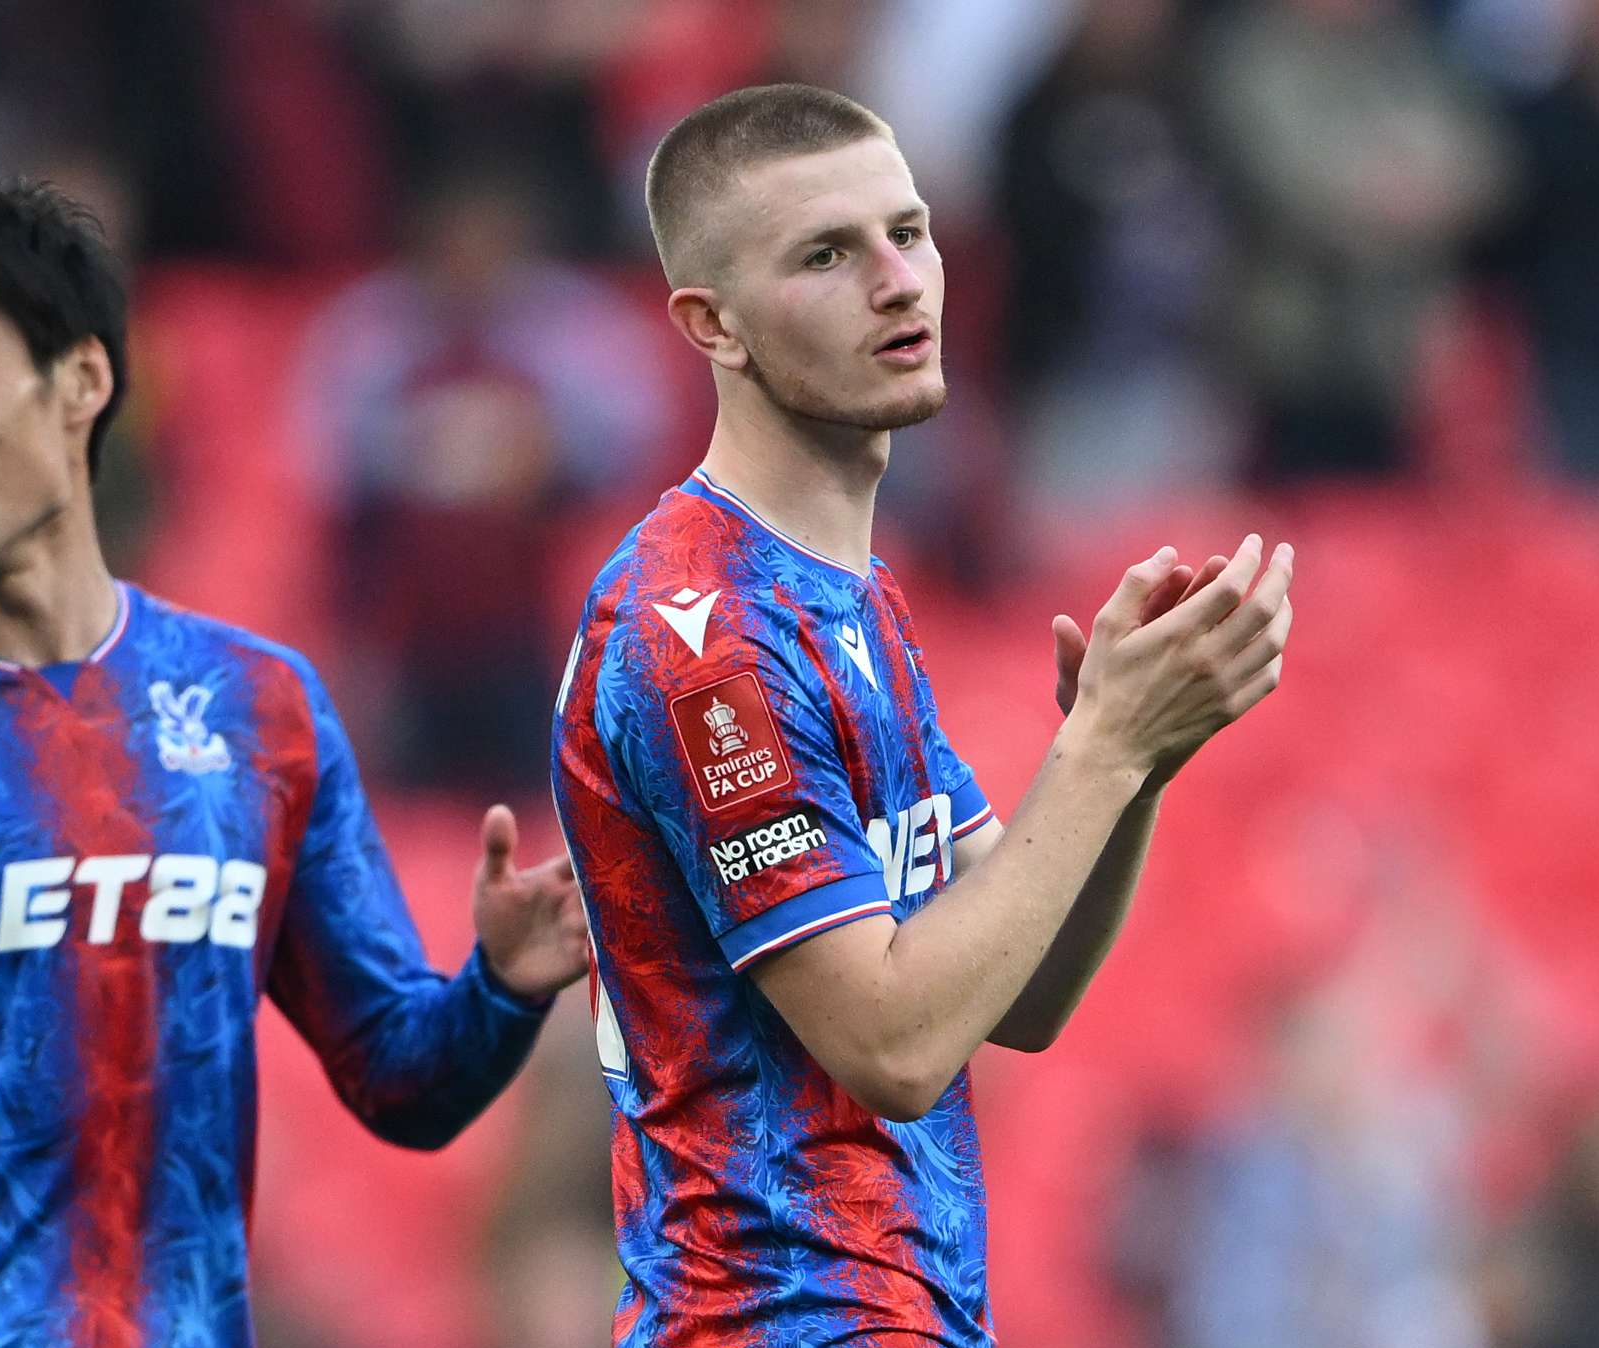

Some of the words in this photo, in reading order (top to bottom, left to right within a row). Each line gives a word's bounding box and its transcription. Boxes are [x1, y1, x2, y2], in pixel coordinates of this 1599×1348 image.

[702, 747, 772, 781] Emirates
[709, 778, 736, 799] FA
[737, 761, 777, 788] CUP
[709, 840, 745, 866] No
[745, 813, 810, 852] room
[718, 858, 749, 886] for
[752, 828, 827, 871] racism
